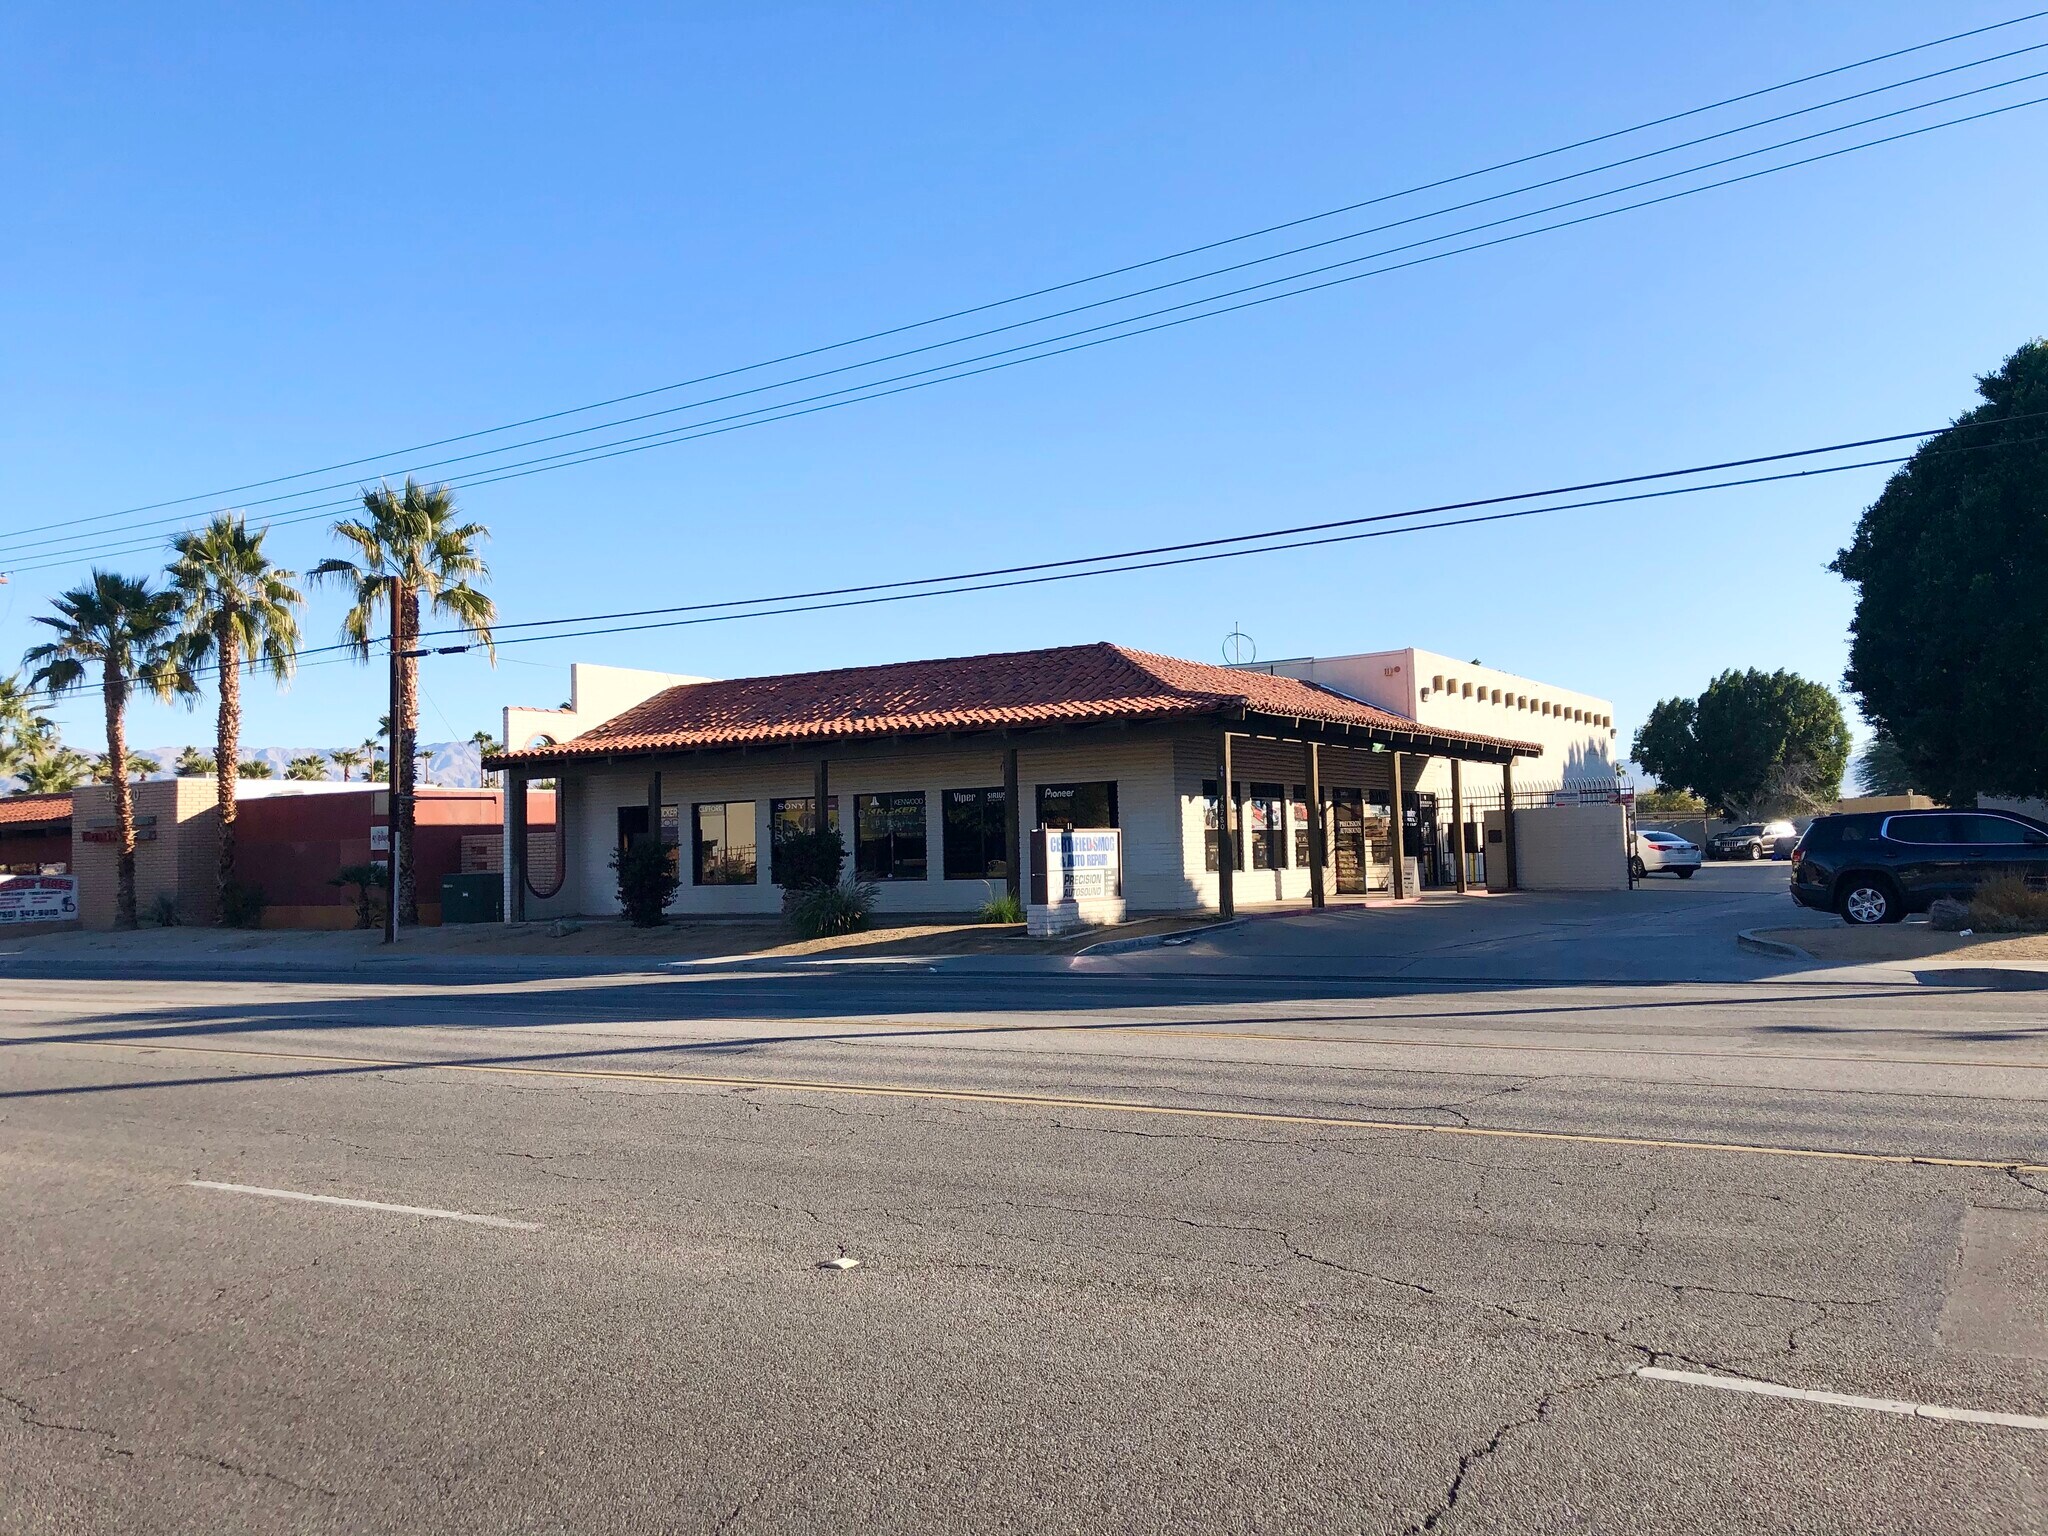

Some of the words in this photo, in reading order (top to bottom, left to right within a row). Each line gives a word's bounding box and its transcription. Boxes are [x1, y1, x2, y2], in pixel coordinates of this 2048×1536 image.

[953, 792, 976, 804] Viper
[1045, 788, 1074, 798] Pioneer
[1050, 836, 1092, 853] CERTIFIED
[1093, 837, 1115, 852] SMOG
[1067, 854, 1085, 867] AUTO
[1087, 854, 1108, 866] REPAIR
[0, 878, 36, 891] ESERT
[40, 878, 73, 891] TIRES
[1064, 874, 1102, 886] PRECISION
[1063, 887, 1101, 898] AUTOSOUND
